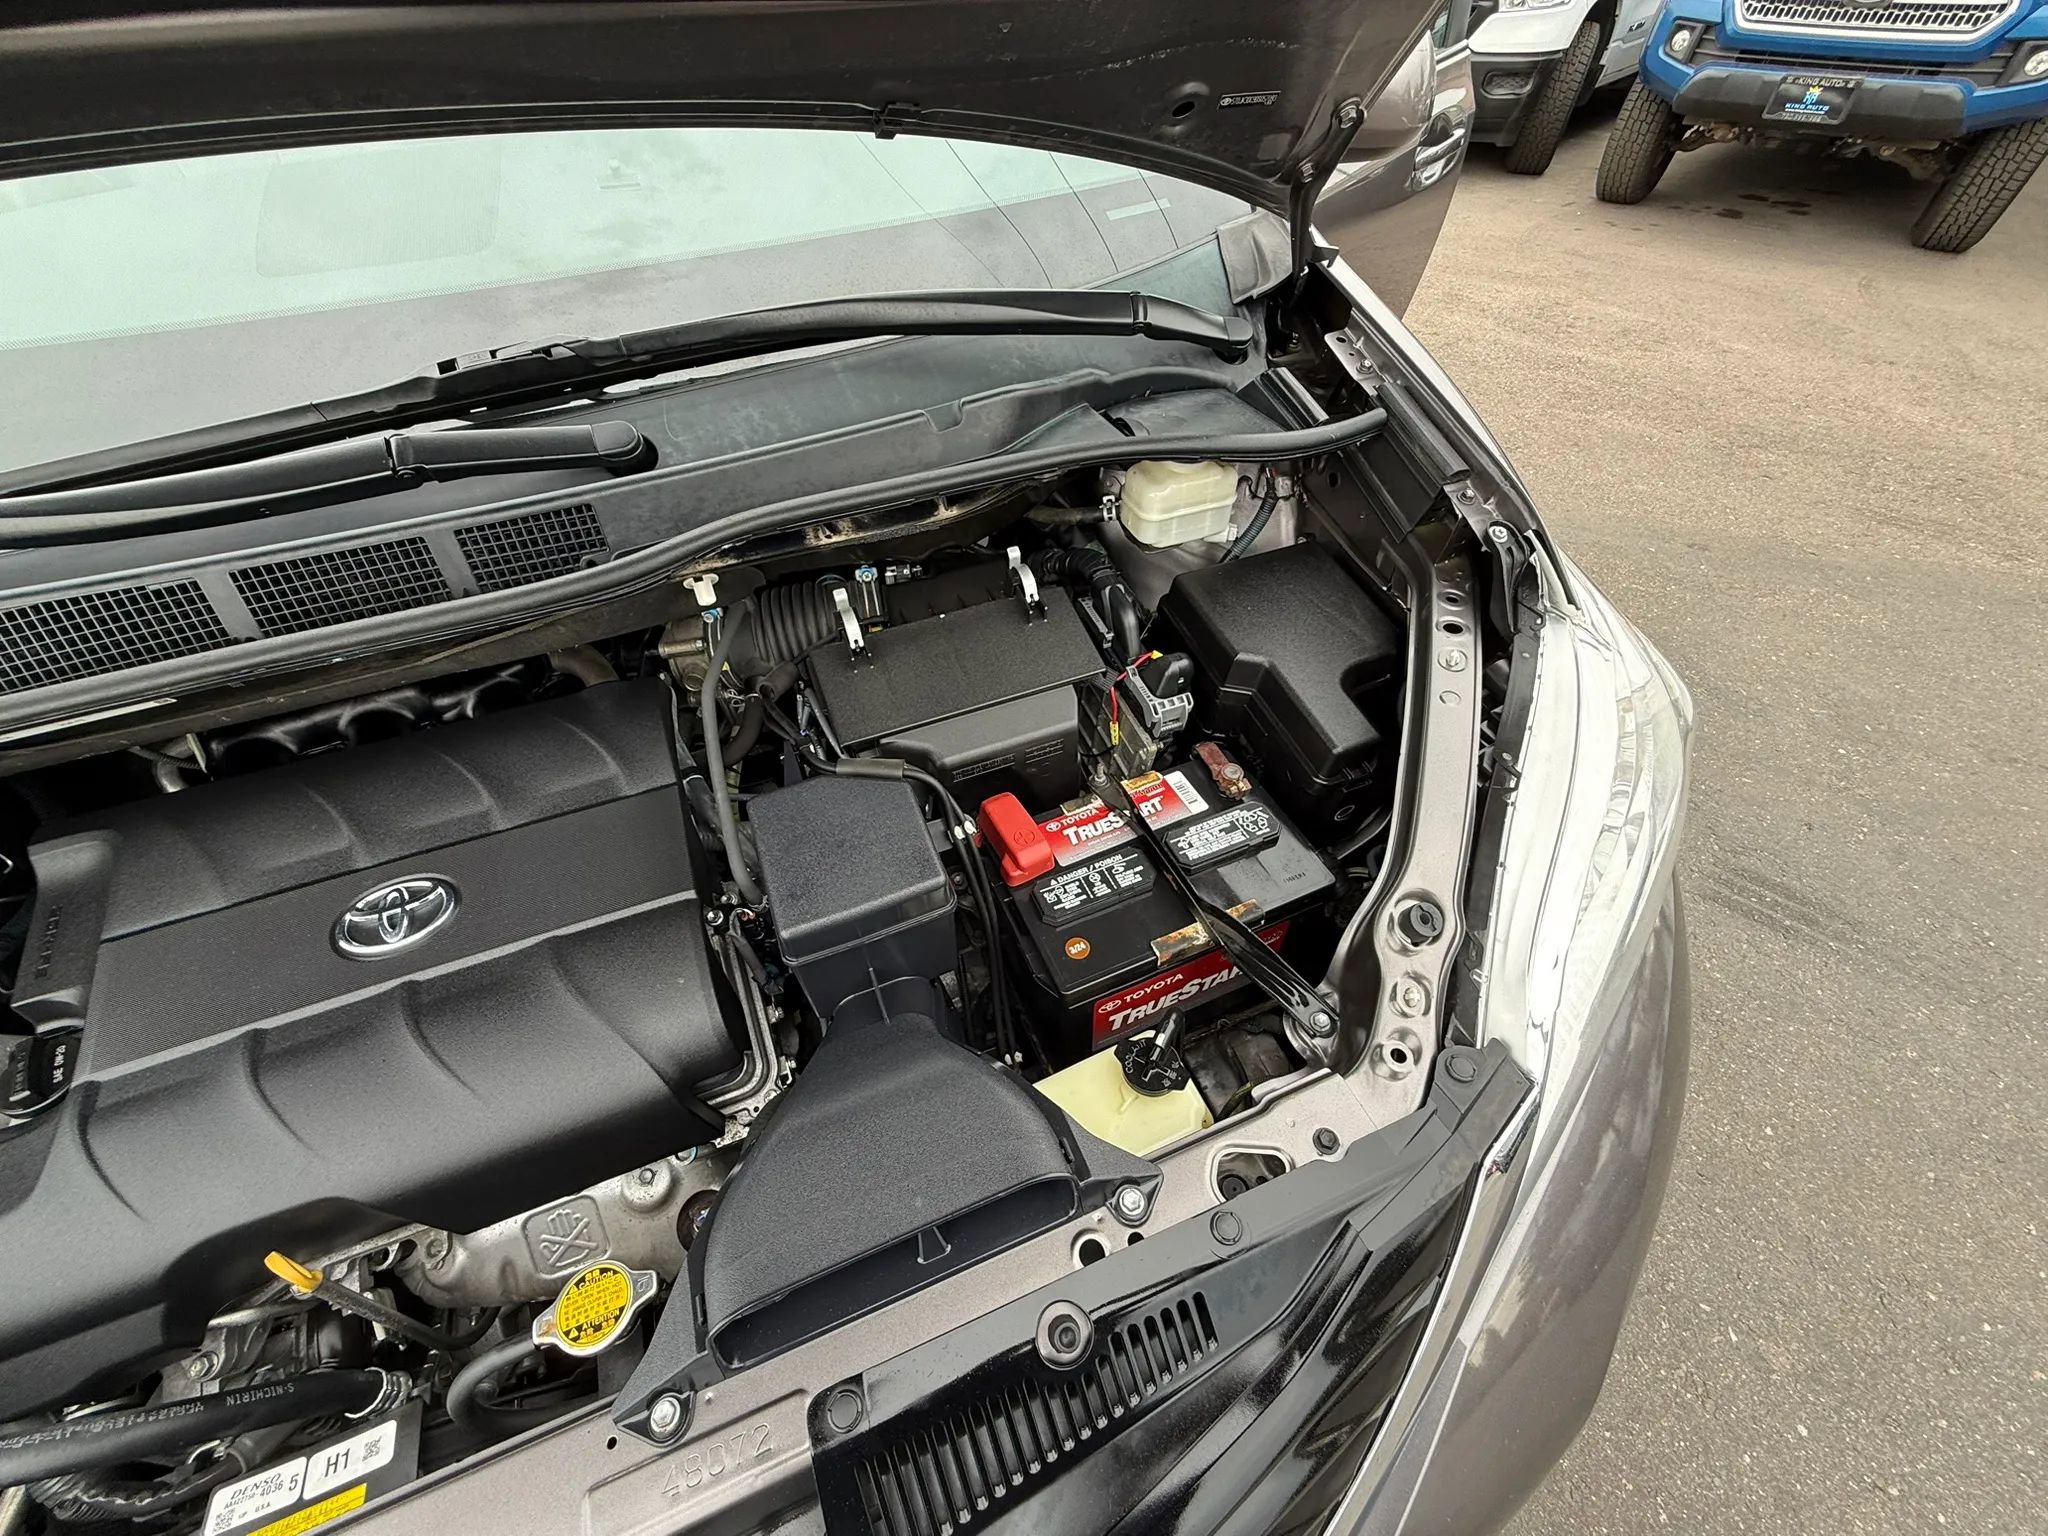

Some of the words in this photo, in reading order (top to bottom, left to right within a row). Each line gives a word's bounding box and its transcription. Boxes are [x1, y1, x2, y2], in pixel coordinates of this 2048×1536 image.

[1060, 808, 1100, 827] TOYOTA
[1063, 795, 1164, 846] TRUESRT
[1057, 867, 1089, 883] DANGER
[1094, 854, 1123, 869] POISON
[1069, 942, 1087, 954] 3/24
[1124, 973, 1184, 1003] TOYOTA
[579, 1269, 614, 1289] CAUTION
[582, 1308, 620, 1331] ATTENTION
[325, 1448, 350, 1478] H1
[661, 1422, 773, 1496] 48072
[230, 1473, 282, 1500] DENSO
[288, 1472, 300, 1491] 5
